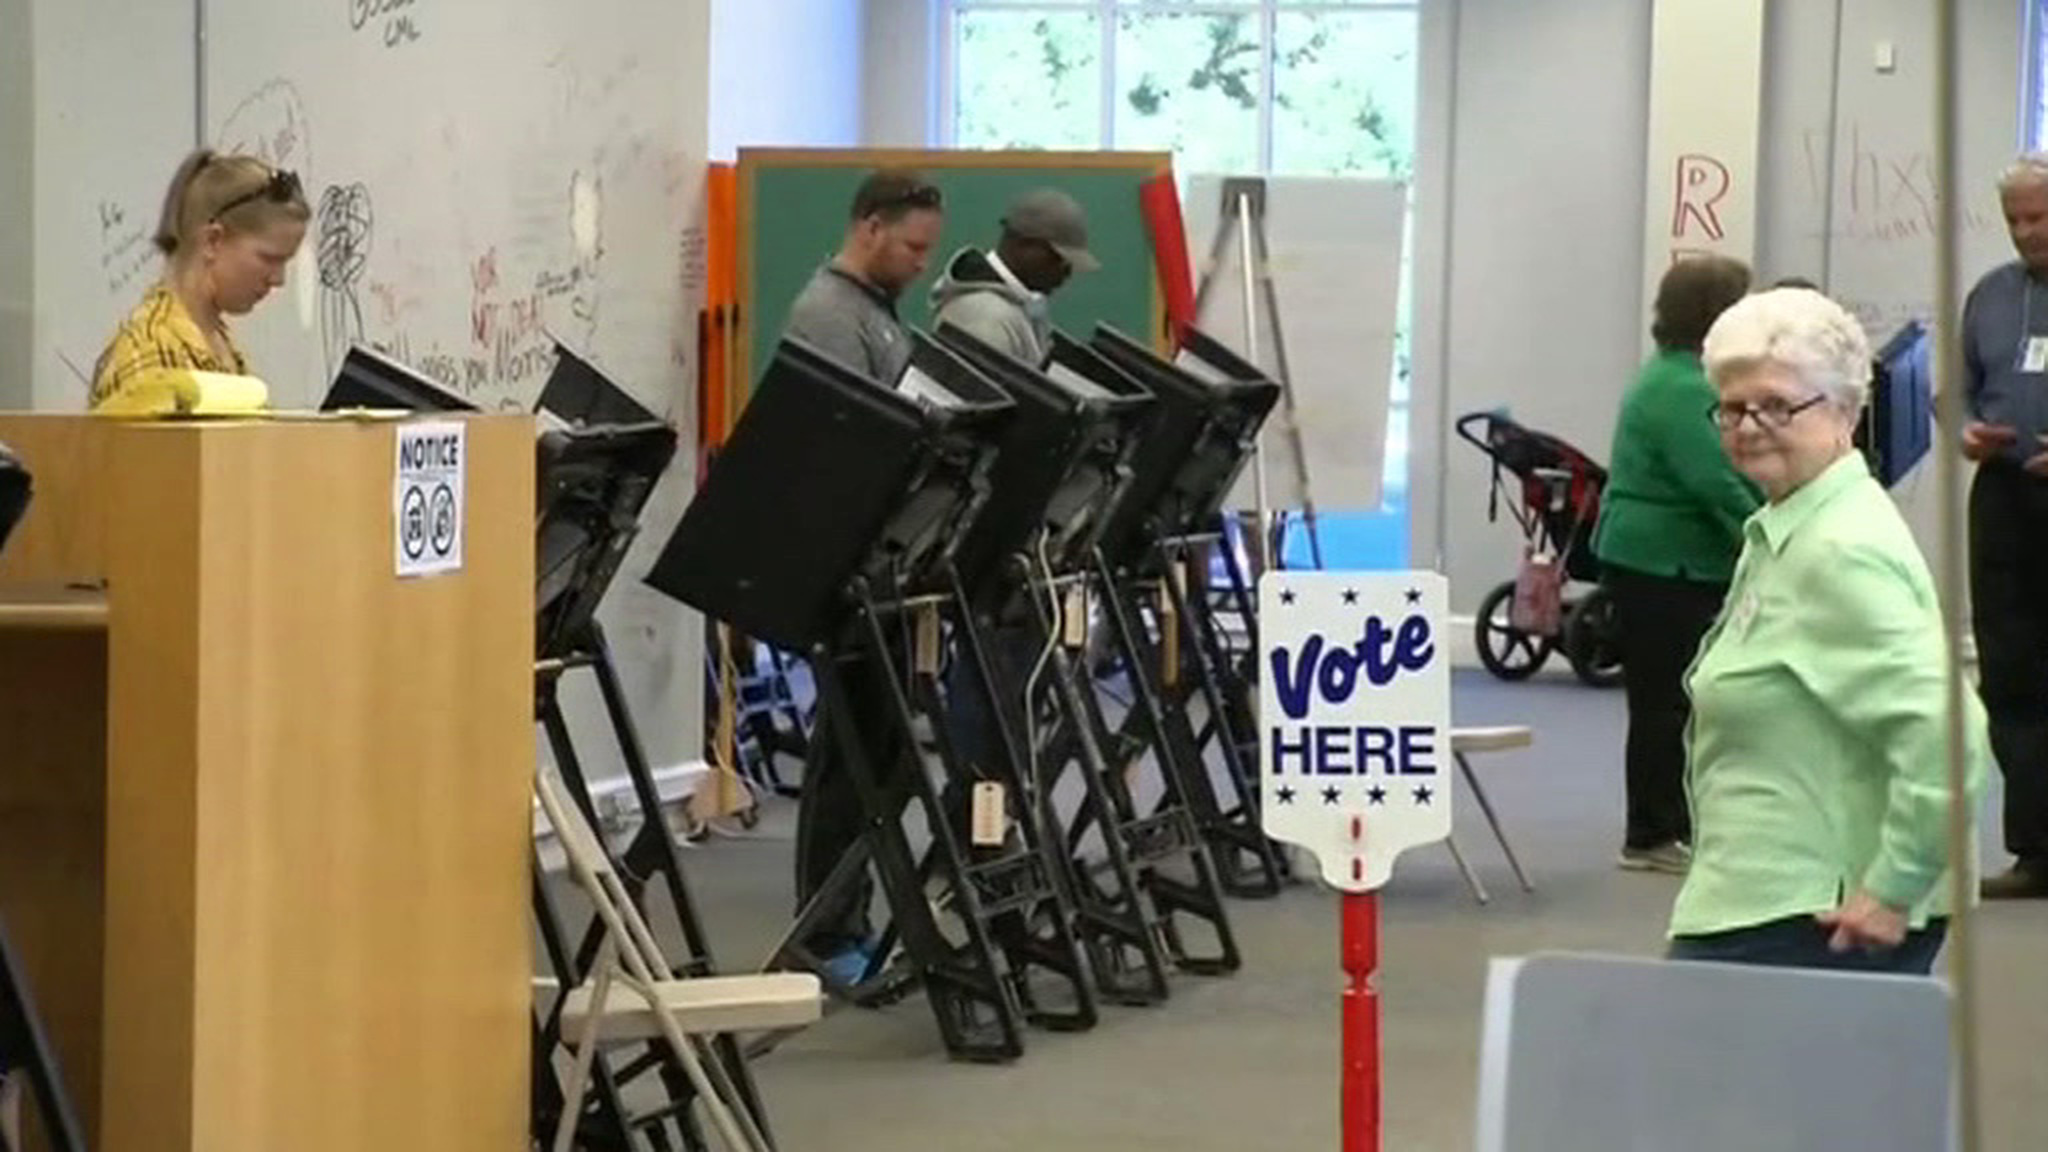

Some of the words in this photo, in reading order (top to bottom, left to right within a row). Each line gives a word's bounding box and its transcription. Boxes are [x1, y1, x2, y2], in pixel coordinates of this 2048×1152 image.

[401, 435, 459, 470] NOTICE
[1270, 615, 1434, 719] Vote
[1272, 727, 1437, 775] HERE
